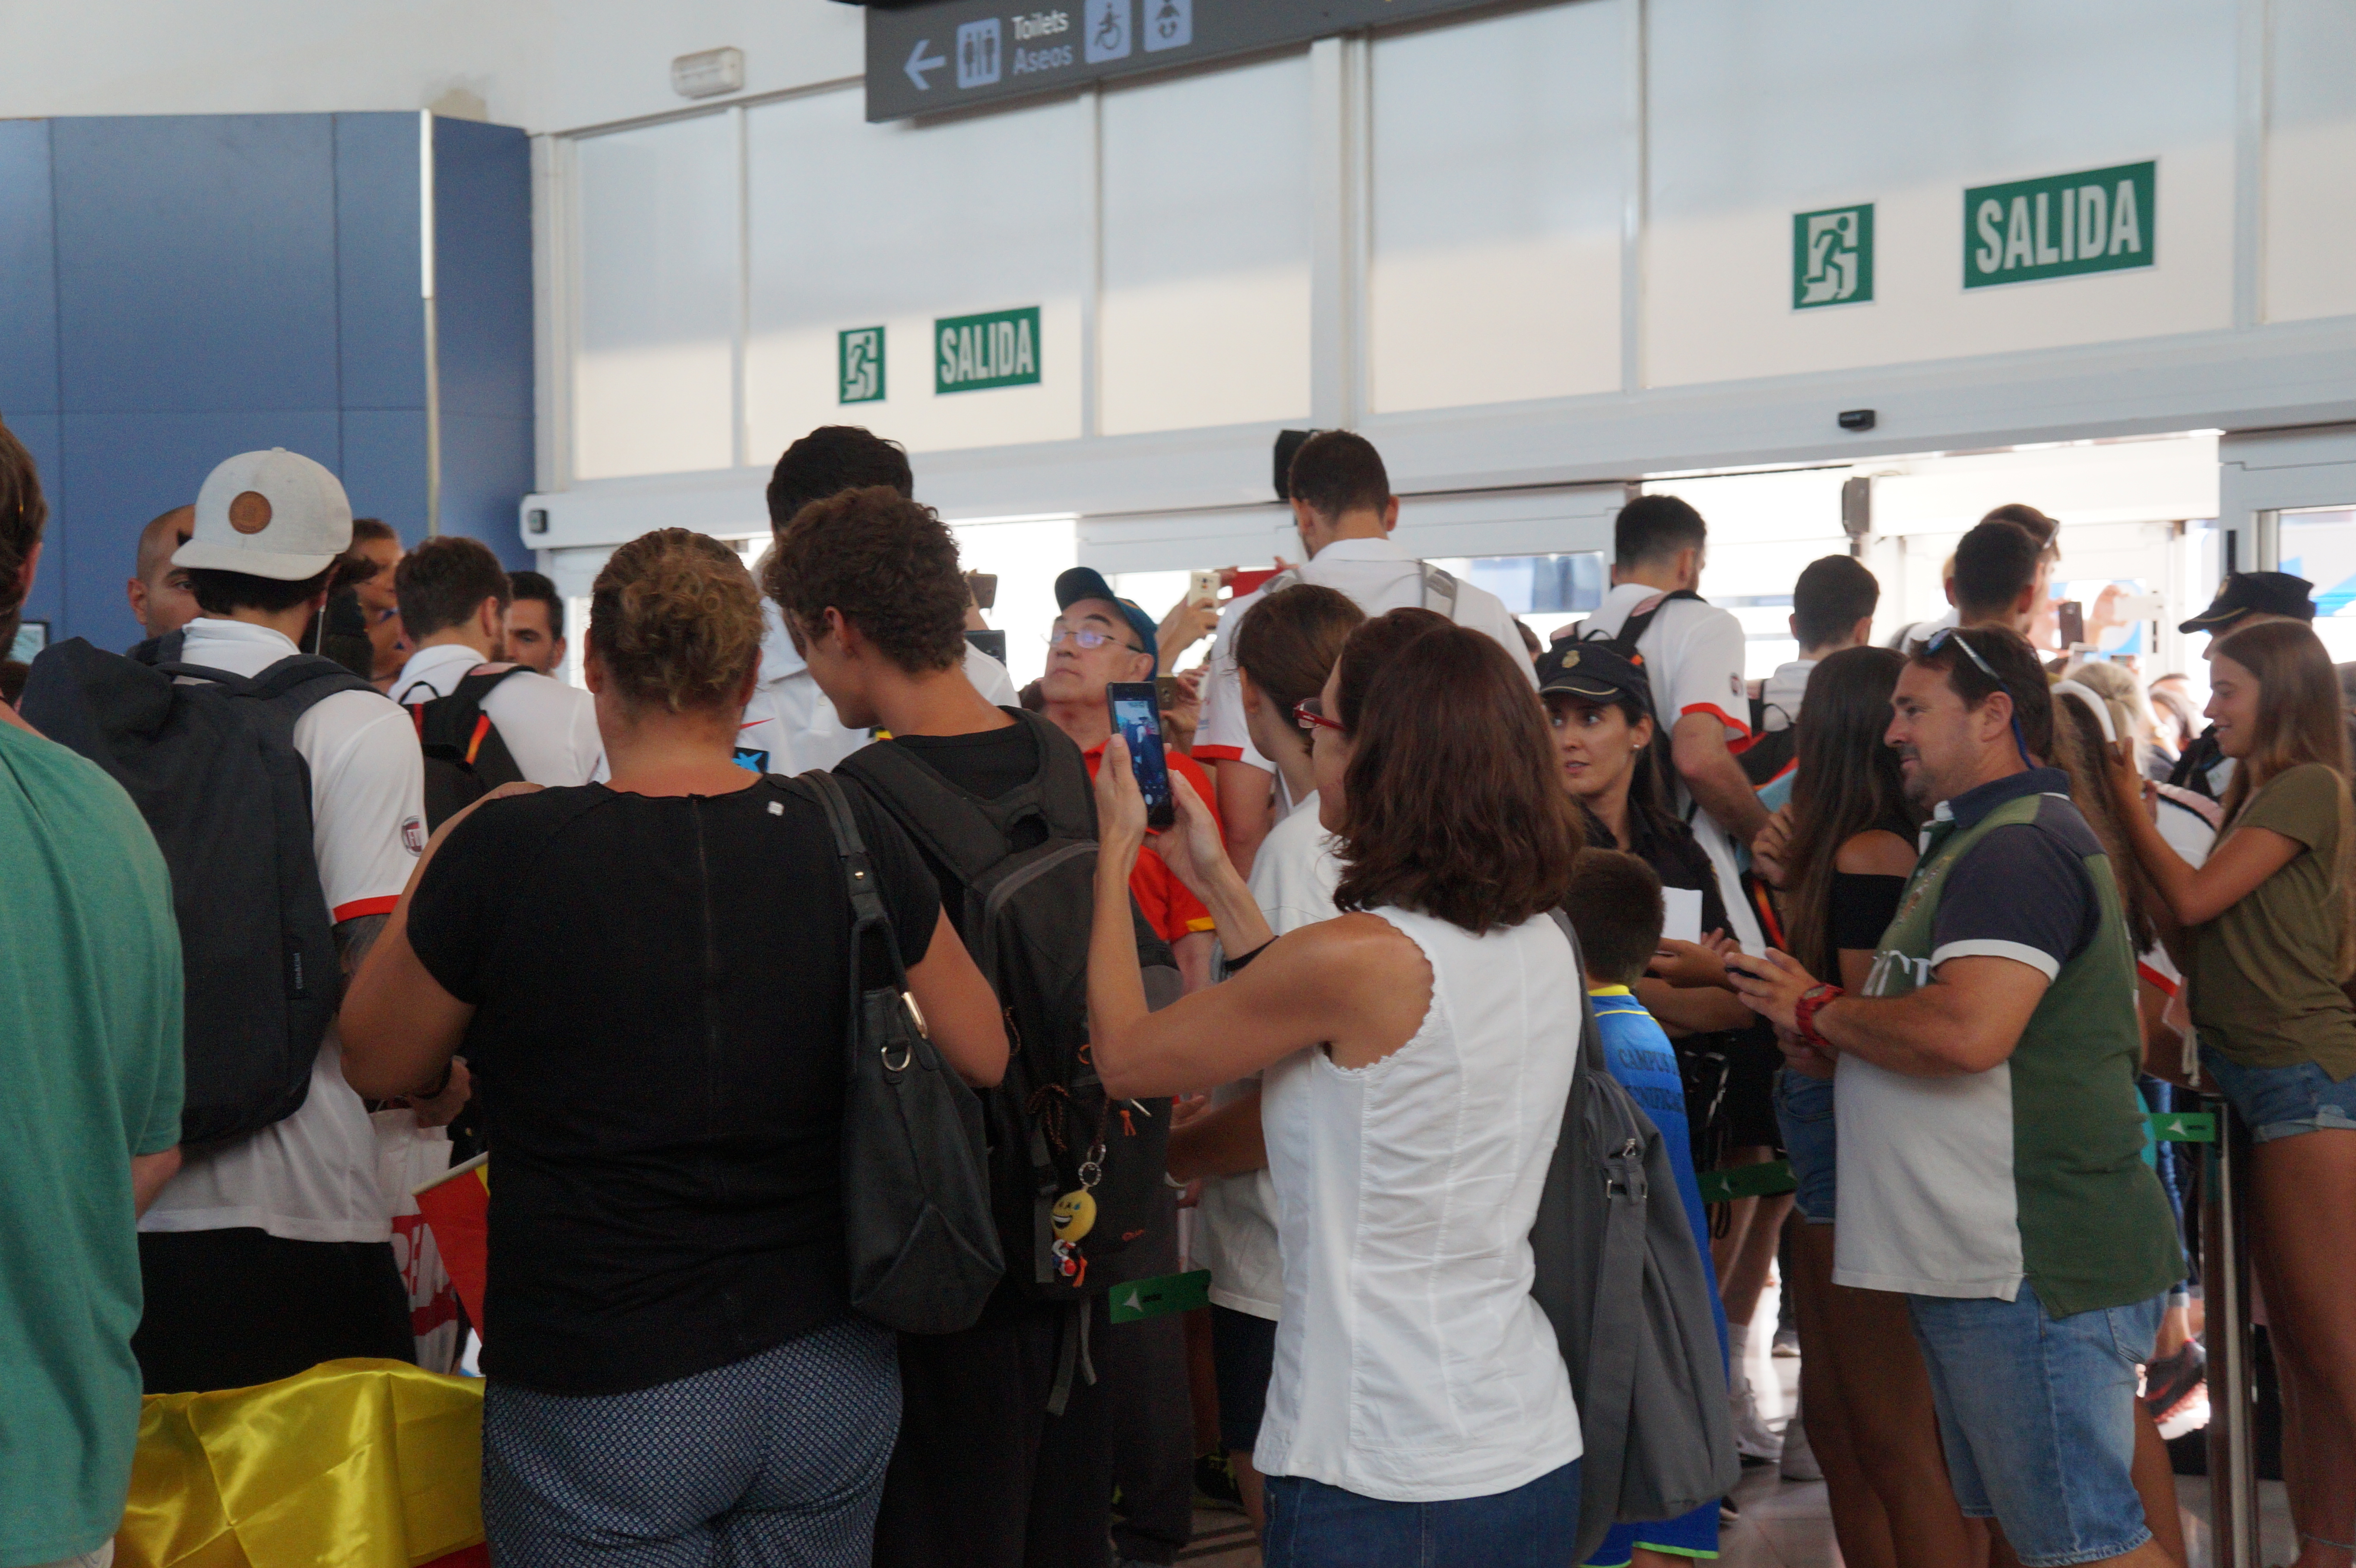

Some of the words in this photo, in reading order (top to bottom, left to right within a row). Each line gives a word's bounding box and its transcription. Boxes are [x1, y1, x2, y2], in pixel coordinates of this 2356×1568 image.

[1011, 9, 1069, 41] Toilets
[1013, 42, 1073, 76] Aseos
[1975, 180, 2141, 274] SALIDA
[940, 318, 1034, 385] SALIDA
